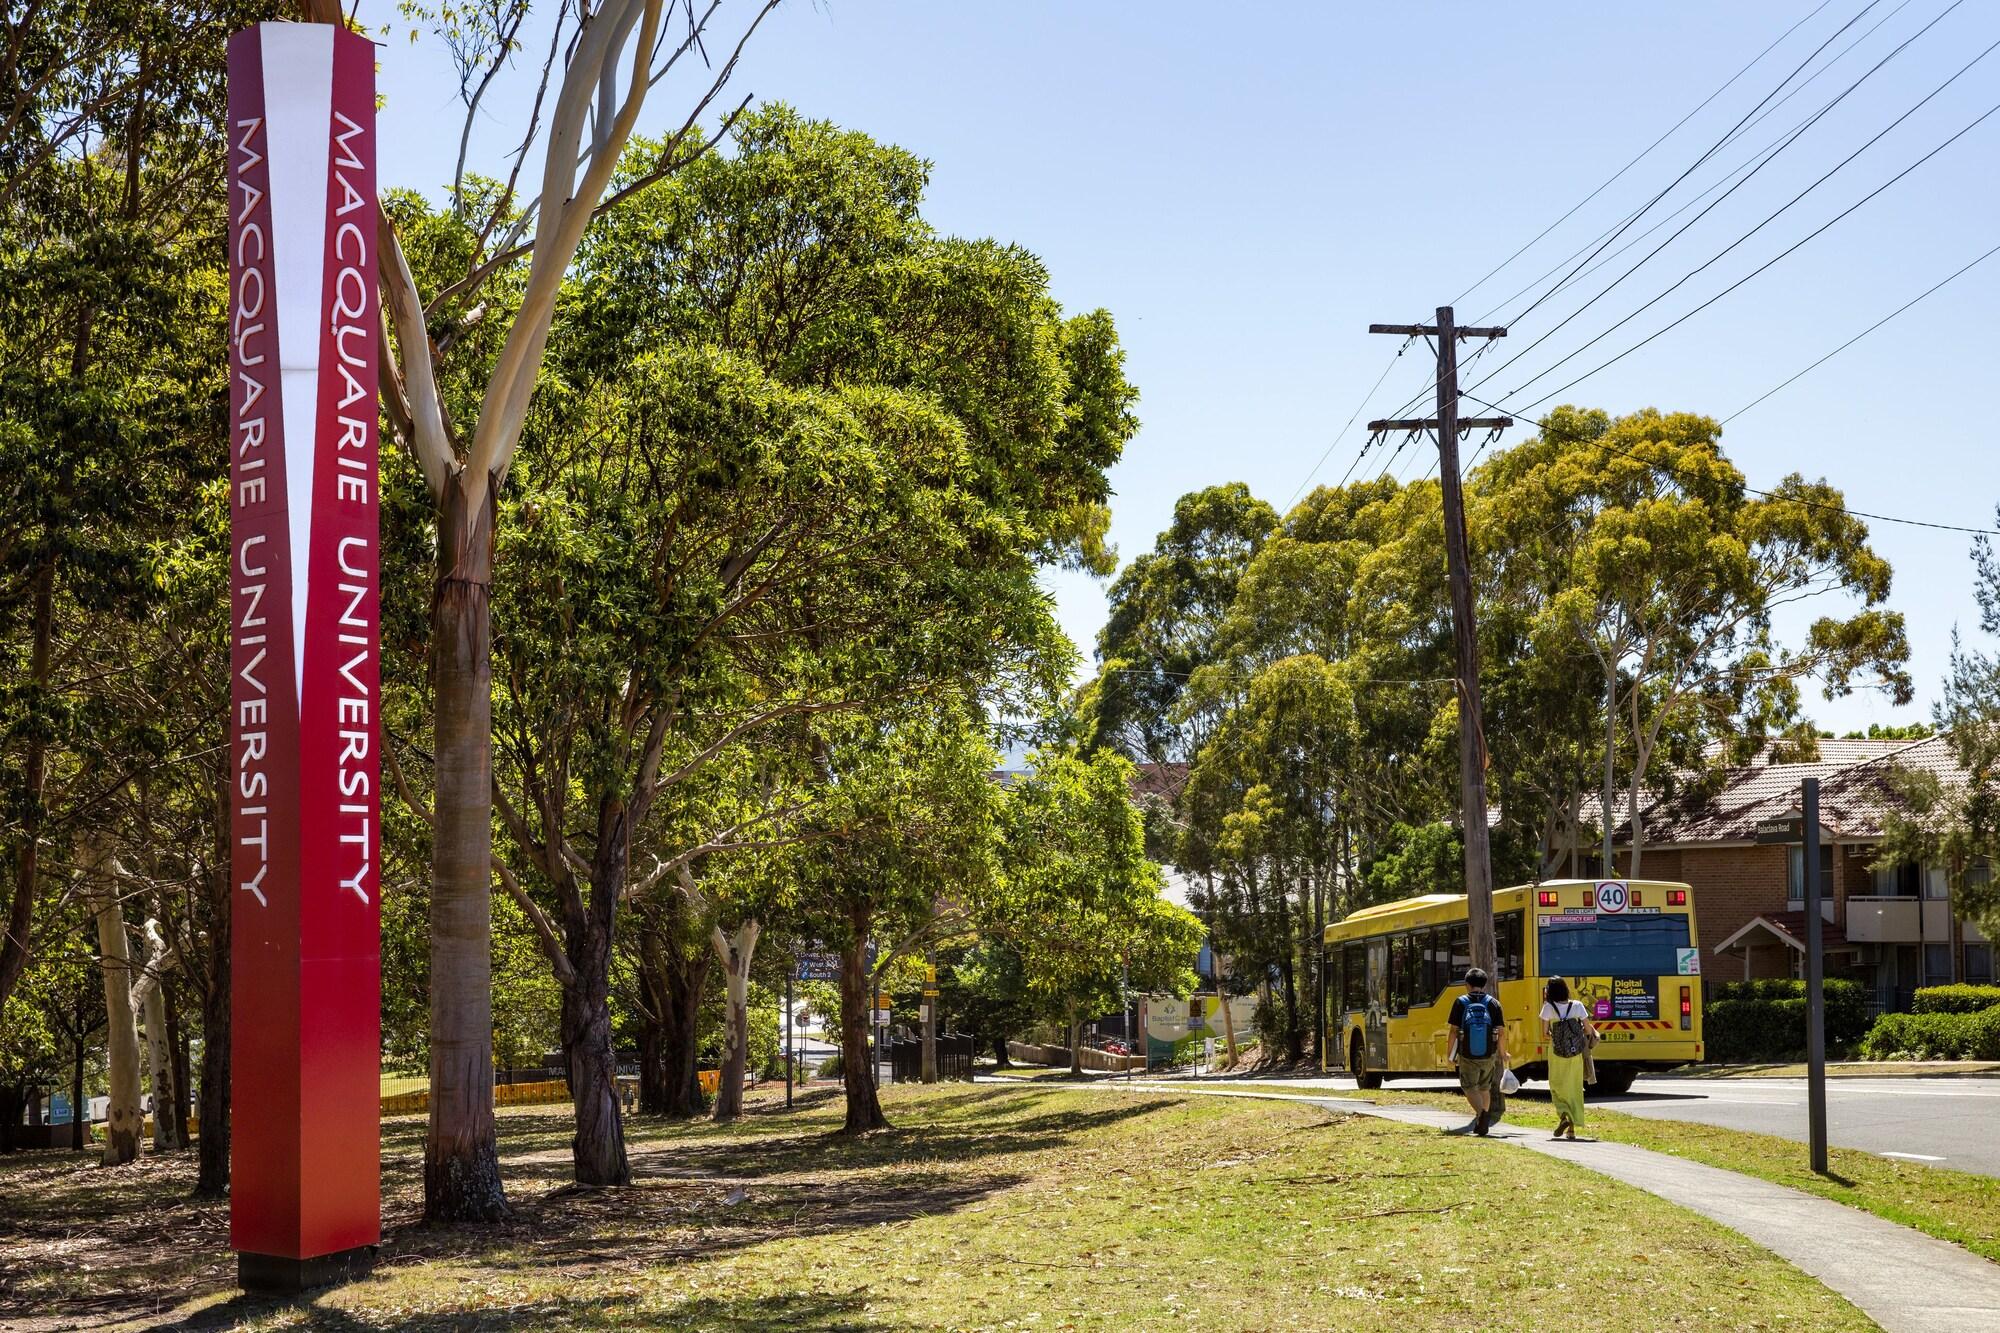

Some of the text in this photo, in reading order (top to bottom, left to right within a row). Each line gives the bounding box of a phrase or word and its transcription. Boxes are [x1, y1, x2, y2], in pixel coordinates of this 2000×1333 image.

[234, 118, 268, 907] MACQUARIE UNIVERSITY
[330, 111, 369, 904] MACQUARIE UNIVERSITY
[1778, 821, 1790, 832] Road
[1601, 889, 1624, 905] 40
[1615, 979, 1642, 988] Digital
